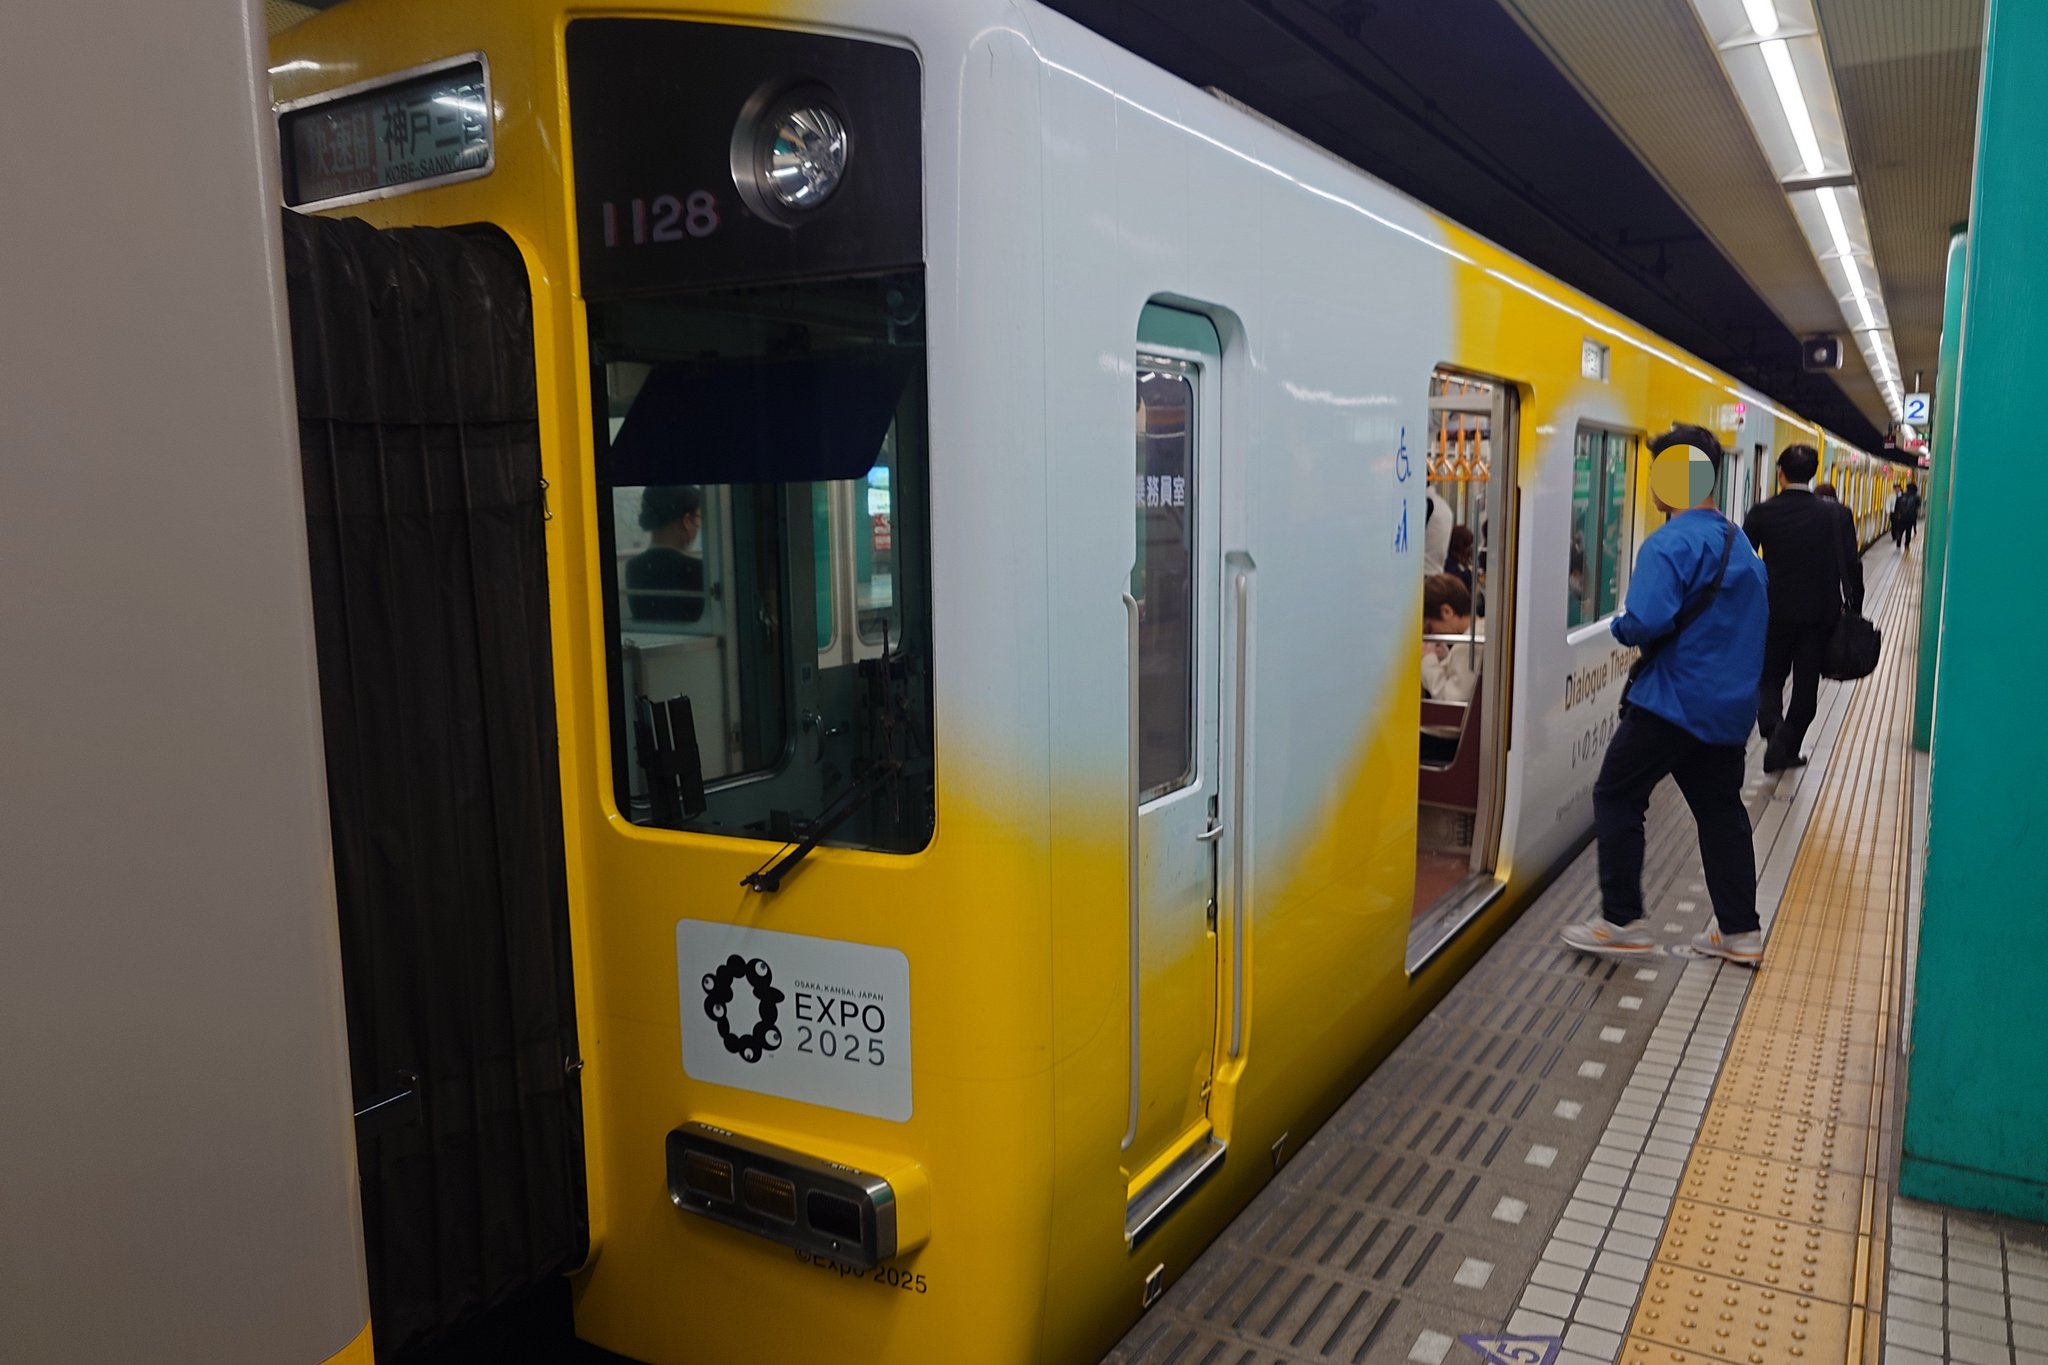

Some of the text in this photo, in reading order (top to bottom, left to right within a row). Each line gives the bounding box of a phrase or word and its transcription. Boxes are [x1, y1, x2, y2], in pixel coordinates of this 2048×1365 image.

[602, 190, 720, 248] 1128
[1908, 399, 1924, 419] 2
[1136, 474, 1185, 507] 乗務員室
[1564, 661, 1608, 712] Dialogue
[1571, 711, 1619, 769] いのちのあ
[794, 992, 885, 1033] EXPO
[858, 989, 884, 1001] JAPAN
[797, 1025, 885, 1067] 2025
[873, 1264, 928, 1294] 2025
